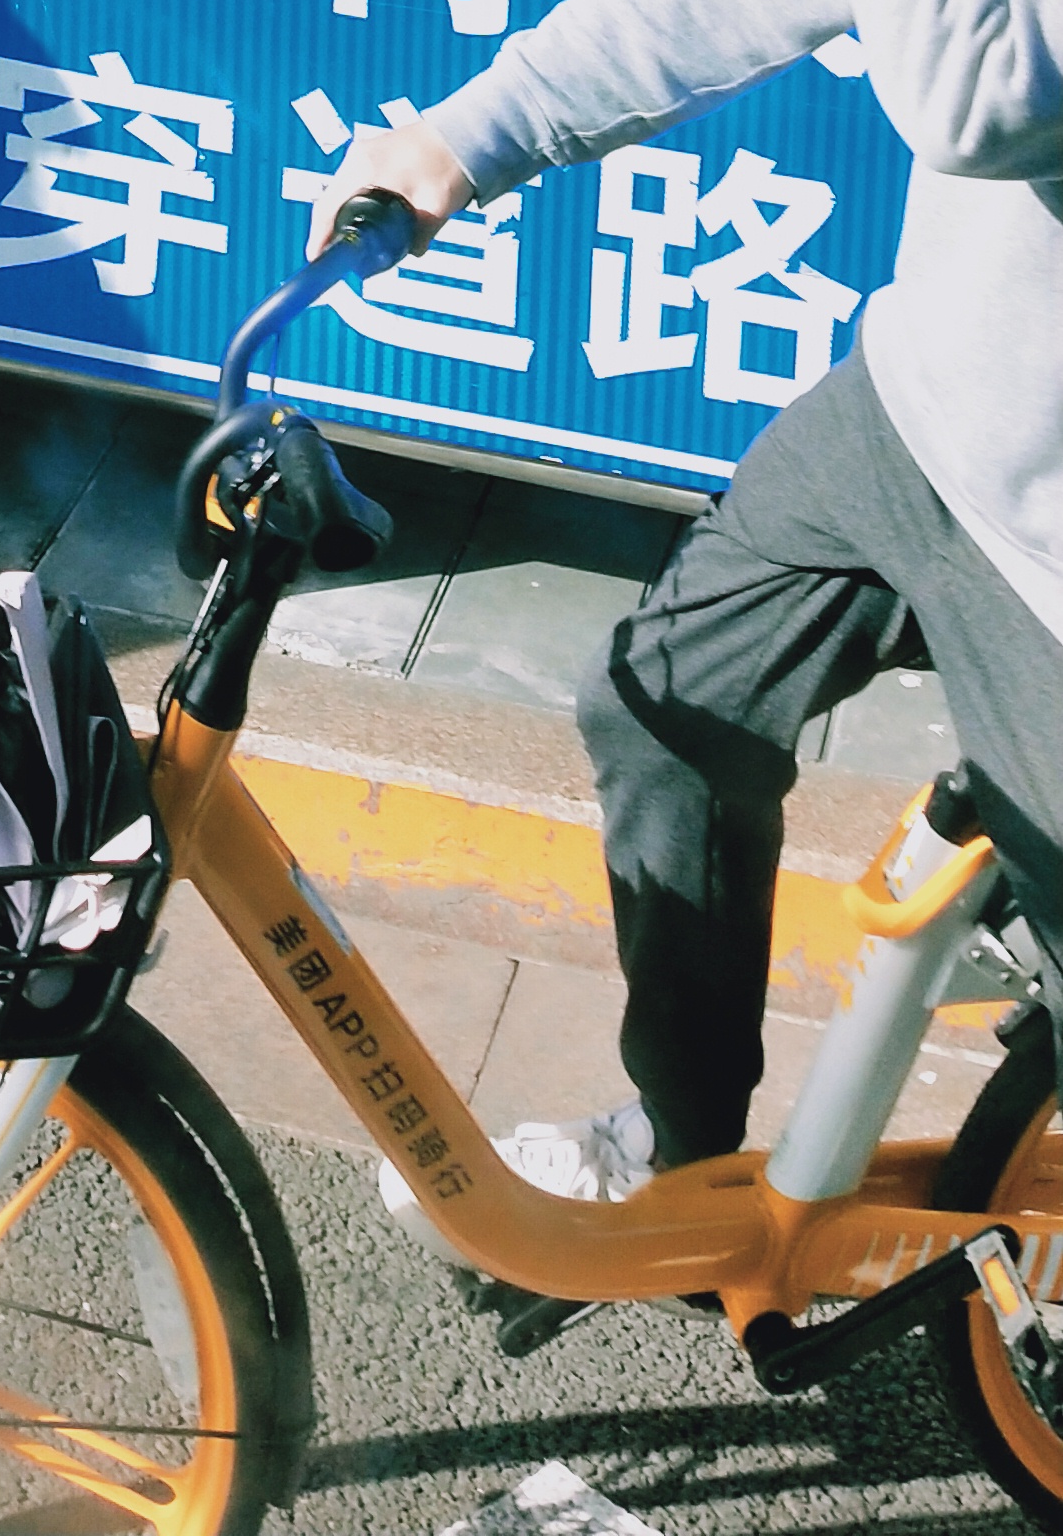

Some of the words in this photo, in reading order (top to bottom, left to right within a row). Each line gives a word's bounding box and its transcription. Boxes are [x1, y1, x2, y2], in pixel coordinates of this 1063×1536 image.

[264, 914, 474, 1199] 美团APP扫码骑行
